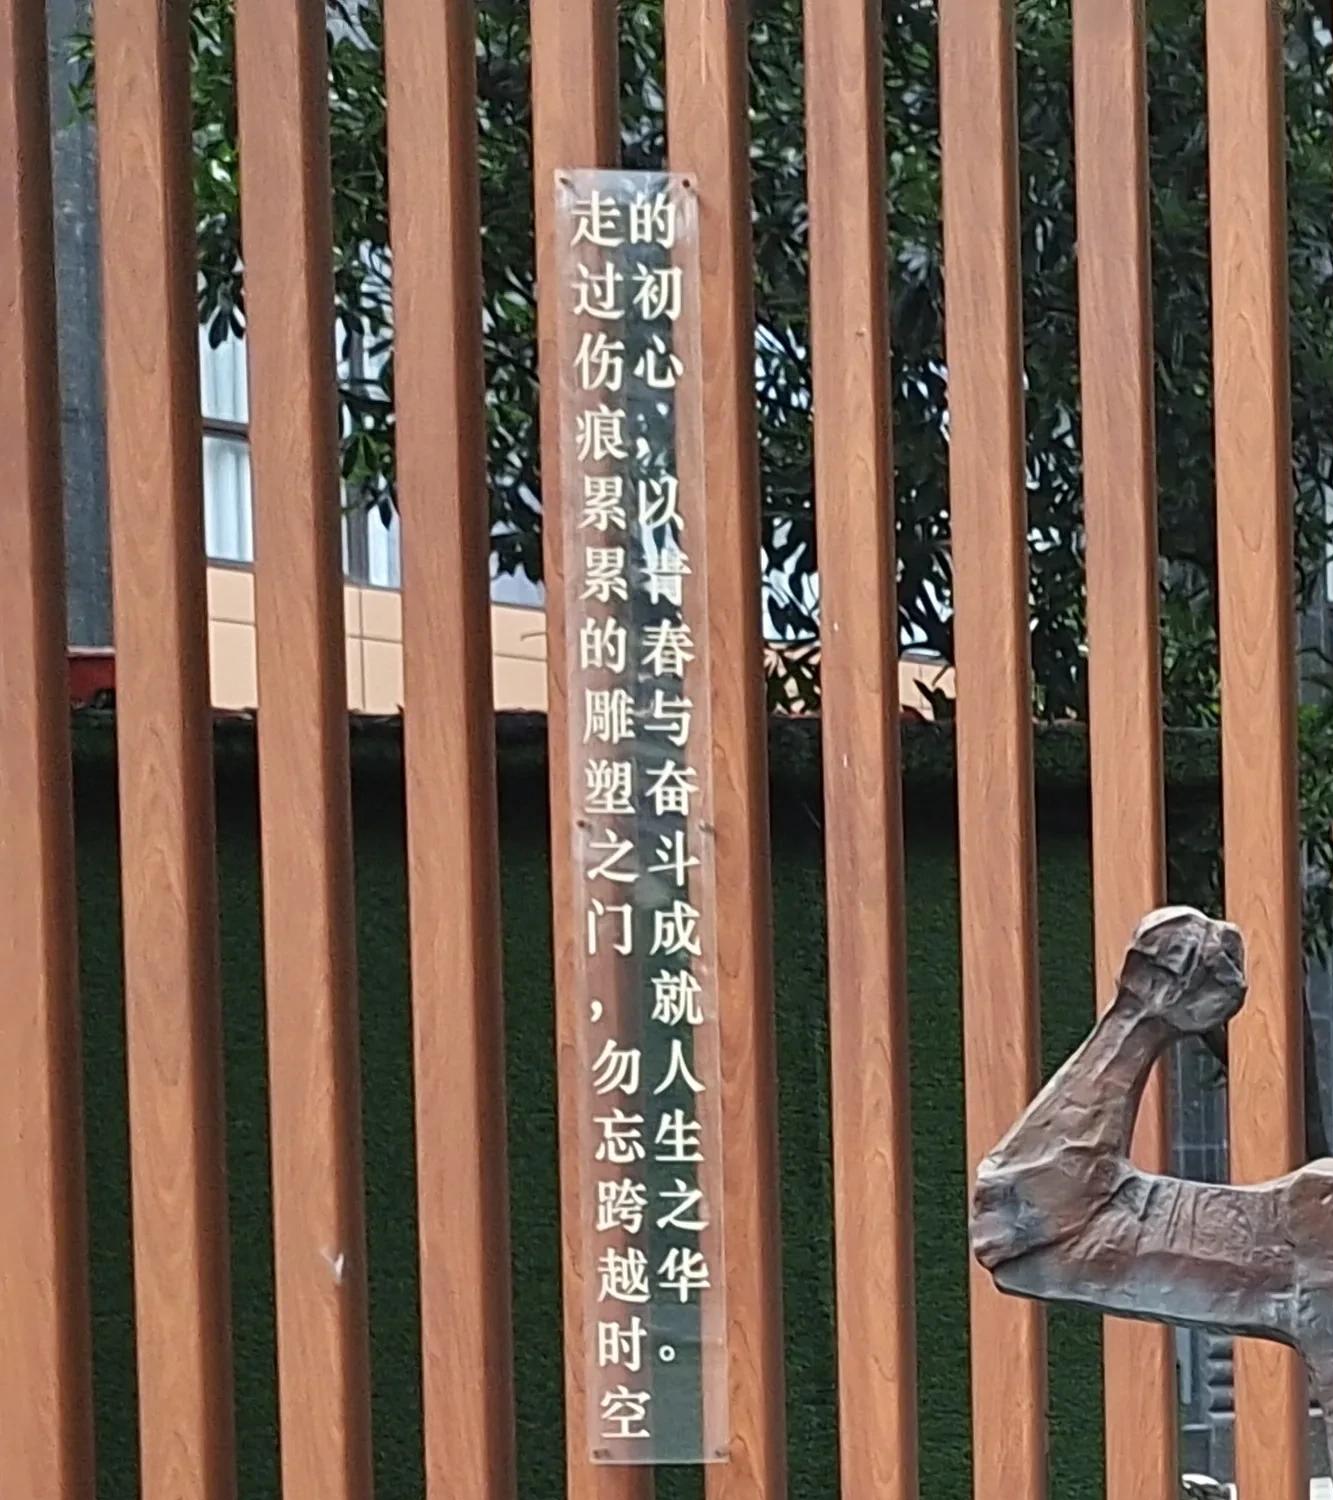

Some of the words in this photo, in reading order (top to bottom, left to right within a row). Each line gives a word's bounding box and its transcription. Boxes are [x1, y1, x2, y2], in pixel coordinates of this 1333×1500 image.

[570, 192, 652, 1439] 走过伤痕累累的雕塑之门，勿忘跨越时空
